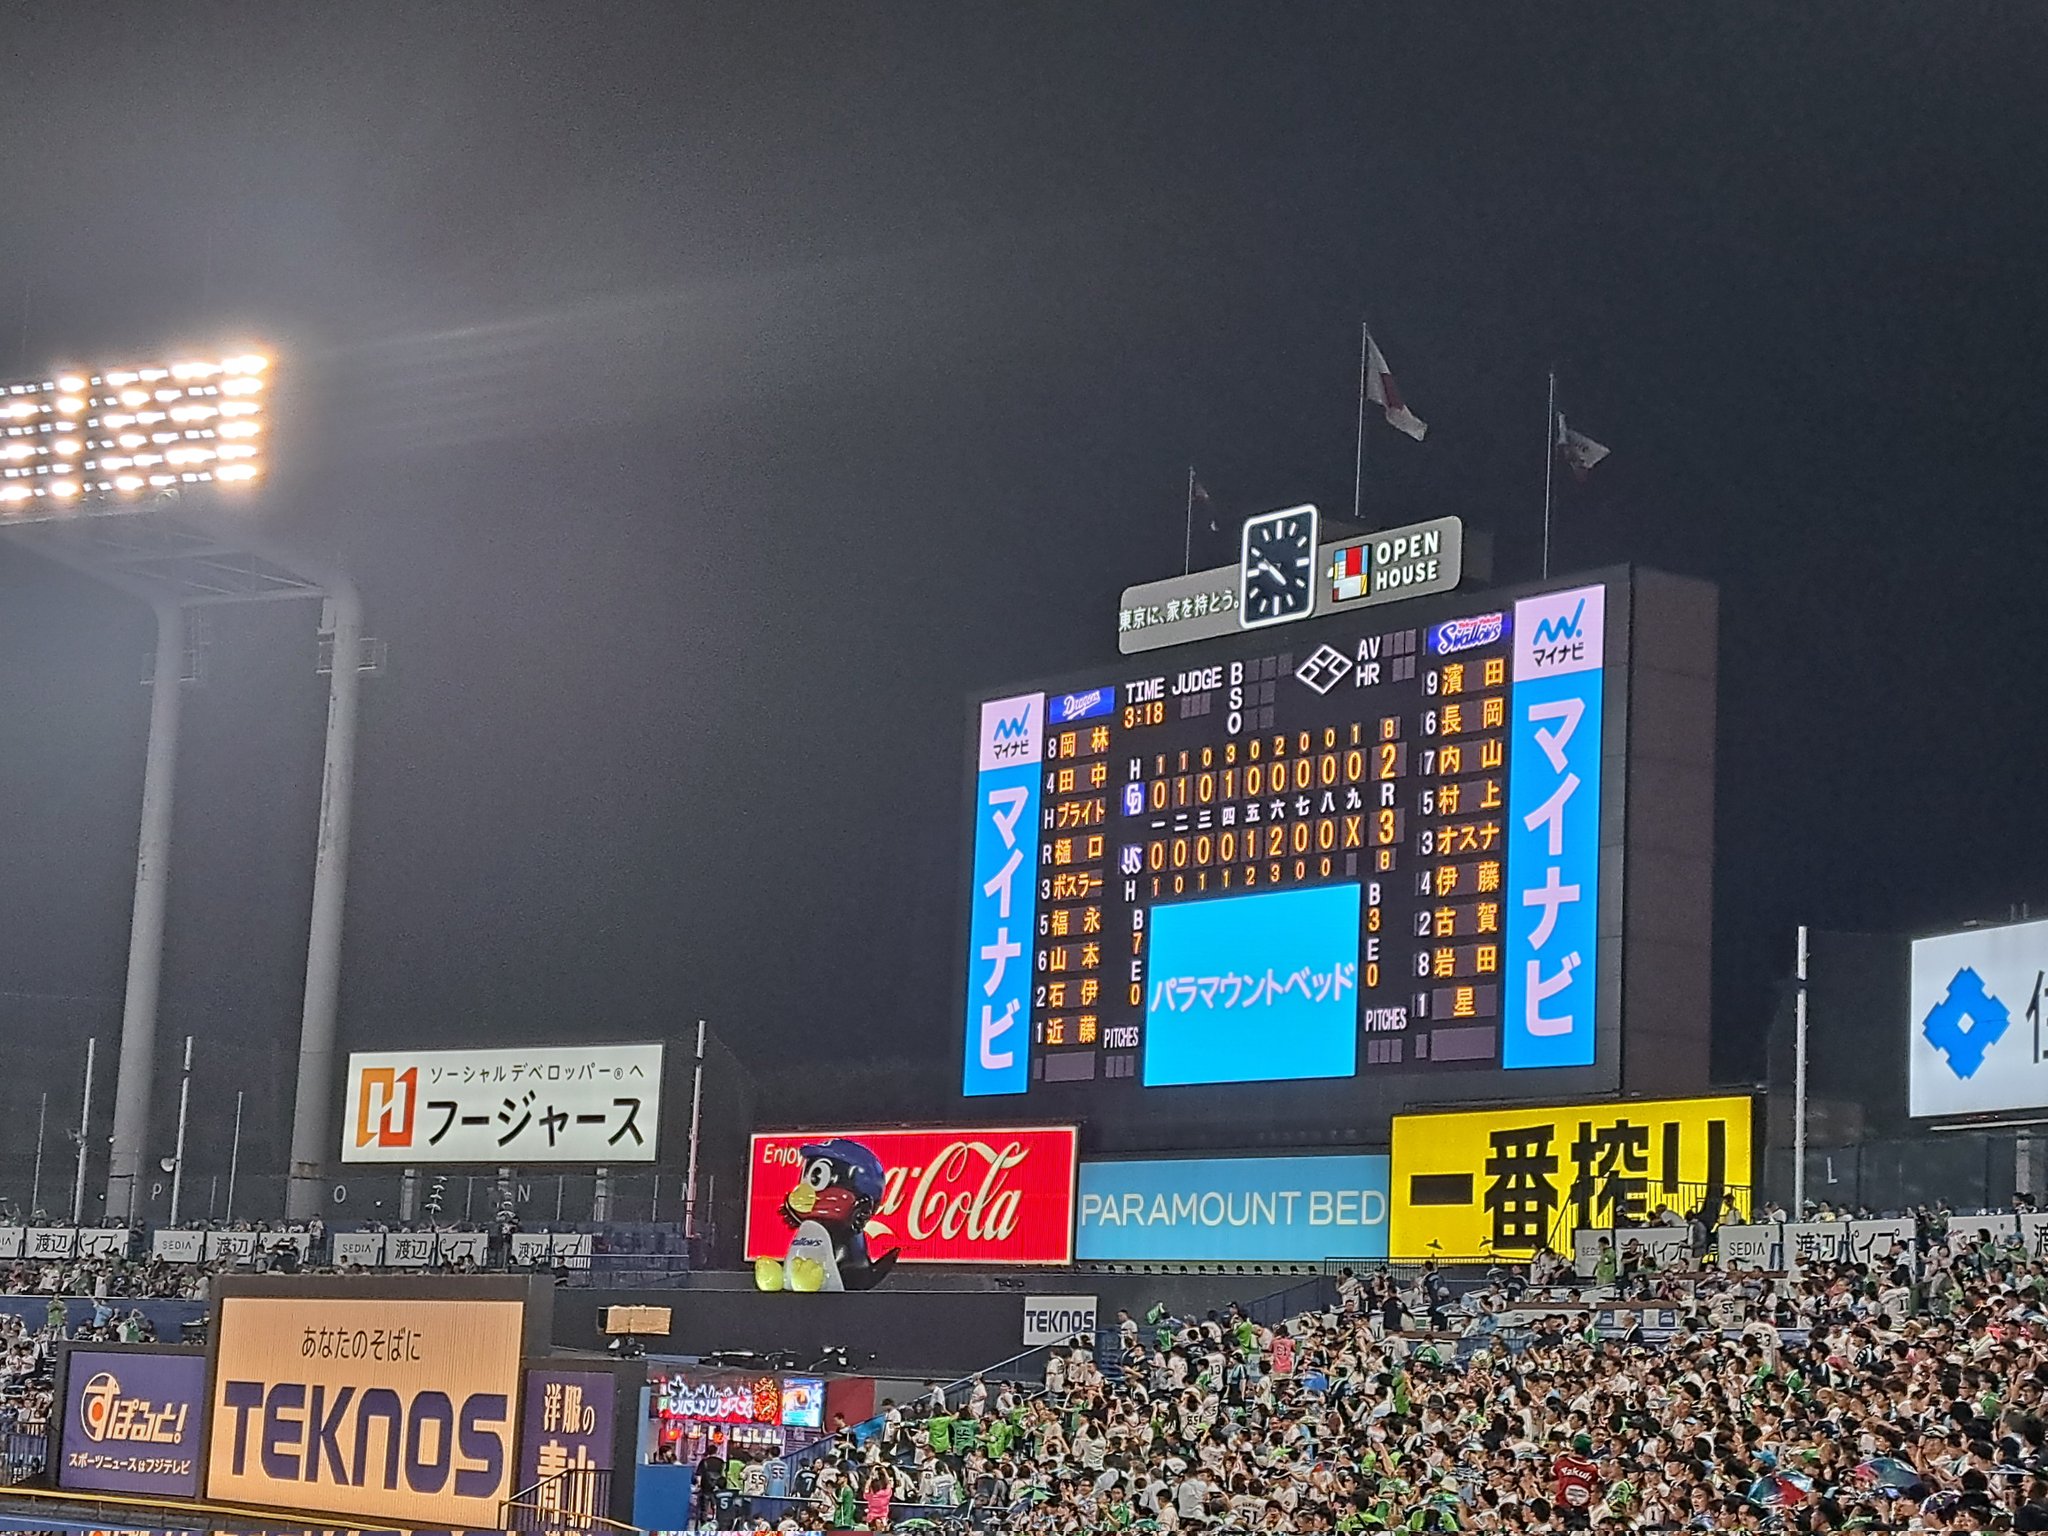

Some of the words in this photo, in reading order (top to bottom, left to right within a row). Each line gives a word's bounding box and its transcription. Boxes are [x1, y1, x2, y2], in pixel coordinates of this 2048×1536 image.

[1376, 530, 1439, 566] OPEN
[1376, 560, 1438, 592] HOUSE
[1119, 590, 1239, 632] 東京に、家を持とう。
[1357, 636, 1381, 662] AV
[1533, 642, 1584, 667] マイナビ
[1126, 677, 1165, 703] TIME
[1172, 667, 1222, 696] JUDGE
[1231, 662, 1243, 684] B
[1356, 664, 1380, 687] HR
[1427, 671, 1438, 695] 9
[1229, 687, 1243, 709] S
[1124, 702, 1164, 728] 3:18
[1425, 712, 1436, 735] 6
[994, 740, 1029, 759] マイナビ
[1048, 738, 1057, 759] 8
[1130, 758, 1140, 780] H
[1157, 756, 1163, 775] 1
[1180, 752, 1186, 770] 1
[1203, 749, 1212, 767] 0
[1226, 745, 1236, 763] 3
[1250, 741, 1260, 759] 0
[1275, 737, 1285, 755] 2
[1300, 733, 1309, 751] 0
[1326, 729, 1335, 748] 0
[1352, 725, 1358, 744] 1
[1384, 719, 1394, 738] 8
[1424, 751, 1435, 775] 7
[1047, 773, 1055, 794] 4
[1153, 781, 1165, 809] 0
[1178, 777, 1185, 805] 1
[1200, 774, 1212, 802] 0
[1225, 770, 1232, 798] 1
[1248, 767, 1260, 795] 0
[1272, 763, 1285, 791] 0
[1297, 759, 1310, 788] 0
[1322, 755, 1336, 784] 0
[1348, 751, 1361, 780] 0
[1381, 743, 1396, 779] 2
[1044, 808, 1054, 829] H
[1058, 800, 1106, 828] ブライト
[1174, 814, 1189, 832] 二
[1197, 810, 1212, 829] 三
[1222, 806, 1235, 826] 四
[1245, 803, 1260, 823] 五
[1270, 799, 1286, 820] 六
[1295, 795, 1311, 816] 七
[1320, 792, 1336, 813] 八
[1346, 788, 1362, 810] 九
[1381, 782, 1395, 807] R
[1423, 791, 1434, 815] 5
[1151, 842, 1163, 870] 0
[1174, 839, 1186, 867] 0
[1197, 836, 1210, 864] 0
[1222, 832, 1234, 861] 0
[1247, 830, 1254, 858] 1
[1270, 826, 1283, 856] 2
[1295, 823, 1308, 852] 0
[1320, 820, 1334, 849] 0
[1346, 816, 1360, 847] X
[1379, 809, 1394, 844] 3
[1421, 832, 1433, 856] 3
[1438, 822, 1499, 855] オスナ
[1043, 844, 1052, 865] R
[1126, 880, 1136, 902] H
[1154, 878, 1159, 897] 1
[1175, 876, 1183, 894] 0
[1199, 873, 1205, 891] 1
[1223, 869, 1229, 888] 1
[1246, 867, 1255, 886] 2
[1271, 864, 1280, 882] 3
[1296, 861, 1305, 880] 0
[1321, 858, 1330, 877] 0
[1381, 850, 1390, 870] 8
[1523, 697, 1586, 1037] マイナビ
[1041, 879, 1050, 900] 3
[1369, 883, 1380, 906] B
[1421, 871, 1431, 895] 4
[980, 786, 1029, 1070] マイナビ
[1039, 914, 1048, 935] 5
[1133, 909, 1143, 930] B
[1369, 909, 1379, 932] 3
[1419, 912, 1430, 936] 2
[1133, 932, 1142, 955] 7
[1367, 938, 1379, 962] E
[1038, 950, 1047, 971] 6
[1131, 961, 1141, 982] E
[1417, 952, 1429, 976] 8
[1151, 962, 1354, 1012] パラマウントベッド
[1366, 964, 1378, 988] 0
[1036, 987, 1045, 1007] 2
[1131, 984, 1140, 1006] 0
[1419, 993, 1426, 1017] 1
[1453, 986, 1477, 1018] 星
[1366, 1008, 1407, 1033] PITCHES
[1036, 1023, 1042, 1043] 1
[1104, 1026, 1138, 1049] PITCHES
[426, 1089, 645, 1148] フージャース
[1410, 1118, 1728, 1250] 一番搾り
[1081, 1191, 1302, 1226] PARAMOUNT
[1309, 1190, 1386, 1226] BED
[1729, 1241, 1765, 1256] SEDIA
[1025, 1310, 1094, 1333] TEKNOS
[301, 1326, 422, 1362] あなたのそばに
[544, 1383, 596, 1436] 洋服の
[223, 1380, 509, 1499] TEKNOS
[69, 1452, 190, 1475] スポーツニュースはフジテレビ
[537, 1439, 596, 1530] 青山
